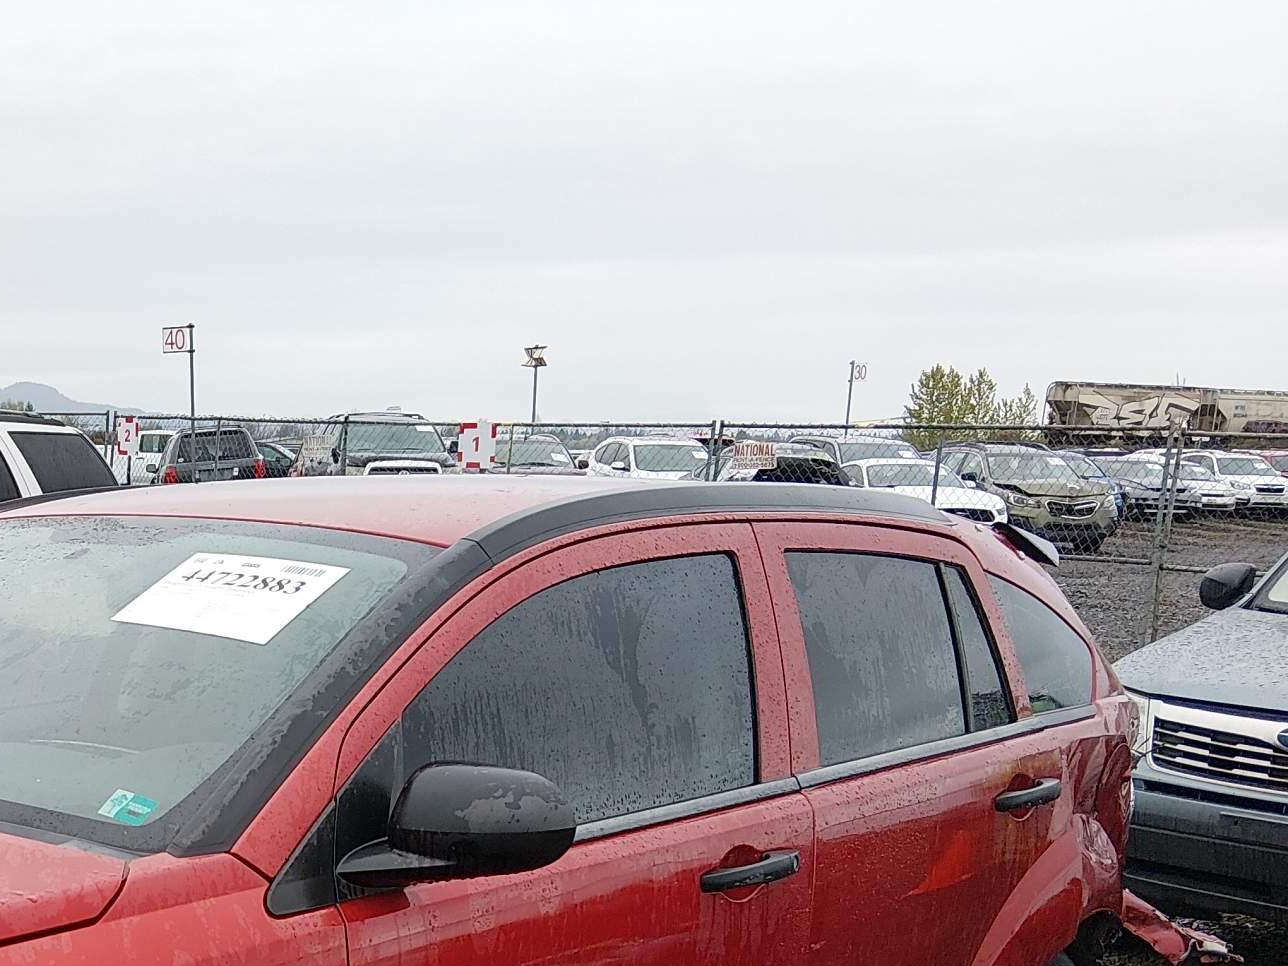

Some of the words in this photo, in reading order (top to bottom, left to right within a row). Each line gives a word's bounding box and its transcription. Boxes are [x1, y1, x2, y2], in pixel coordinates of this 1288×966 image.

[165, 329, 185, 350] 40
[854, 364, 867, 380] 30
[124, 429, 131, 443] 2
[472, 436, 480, 452] 1
[734, 444, 776, 457] NATIONAL
[181, 568, 307, 594] 44722883
